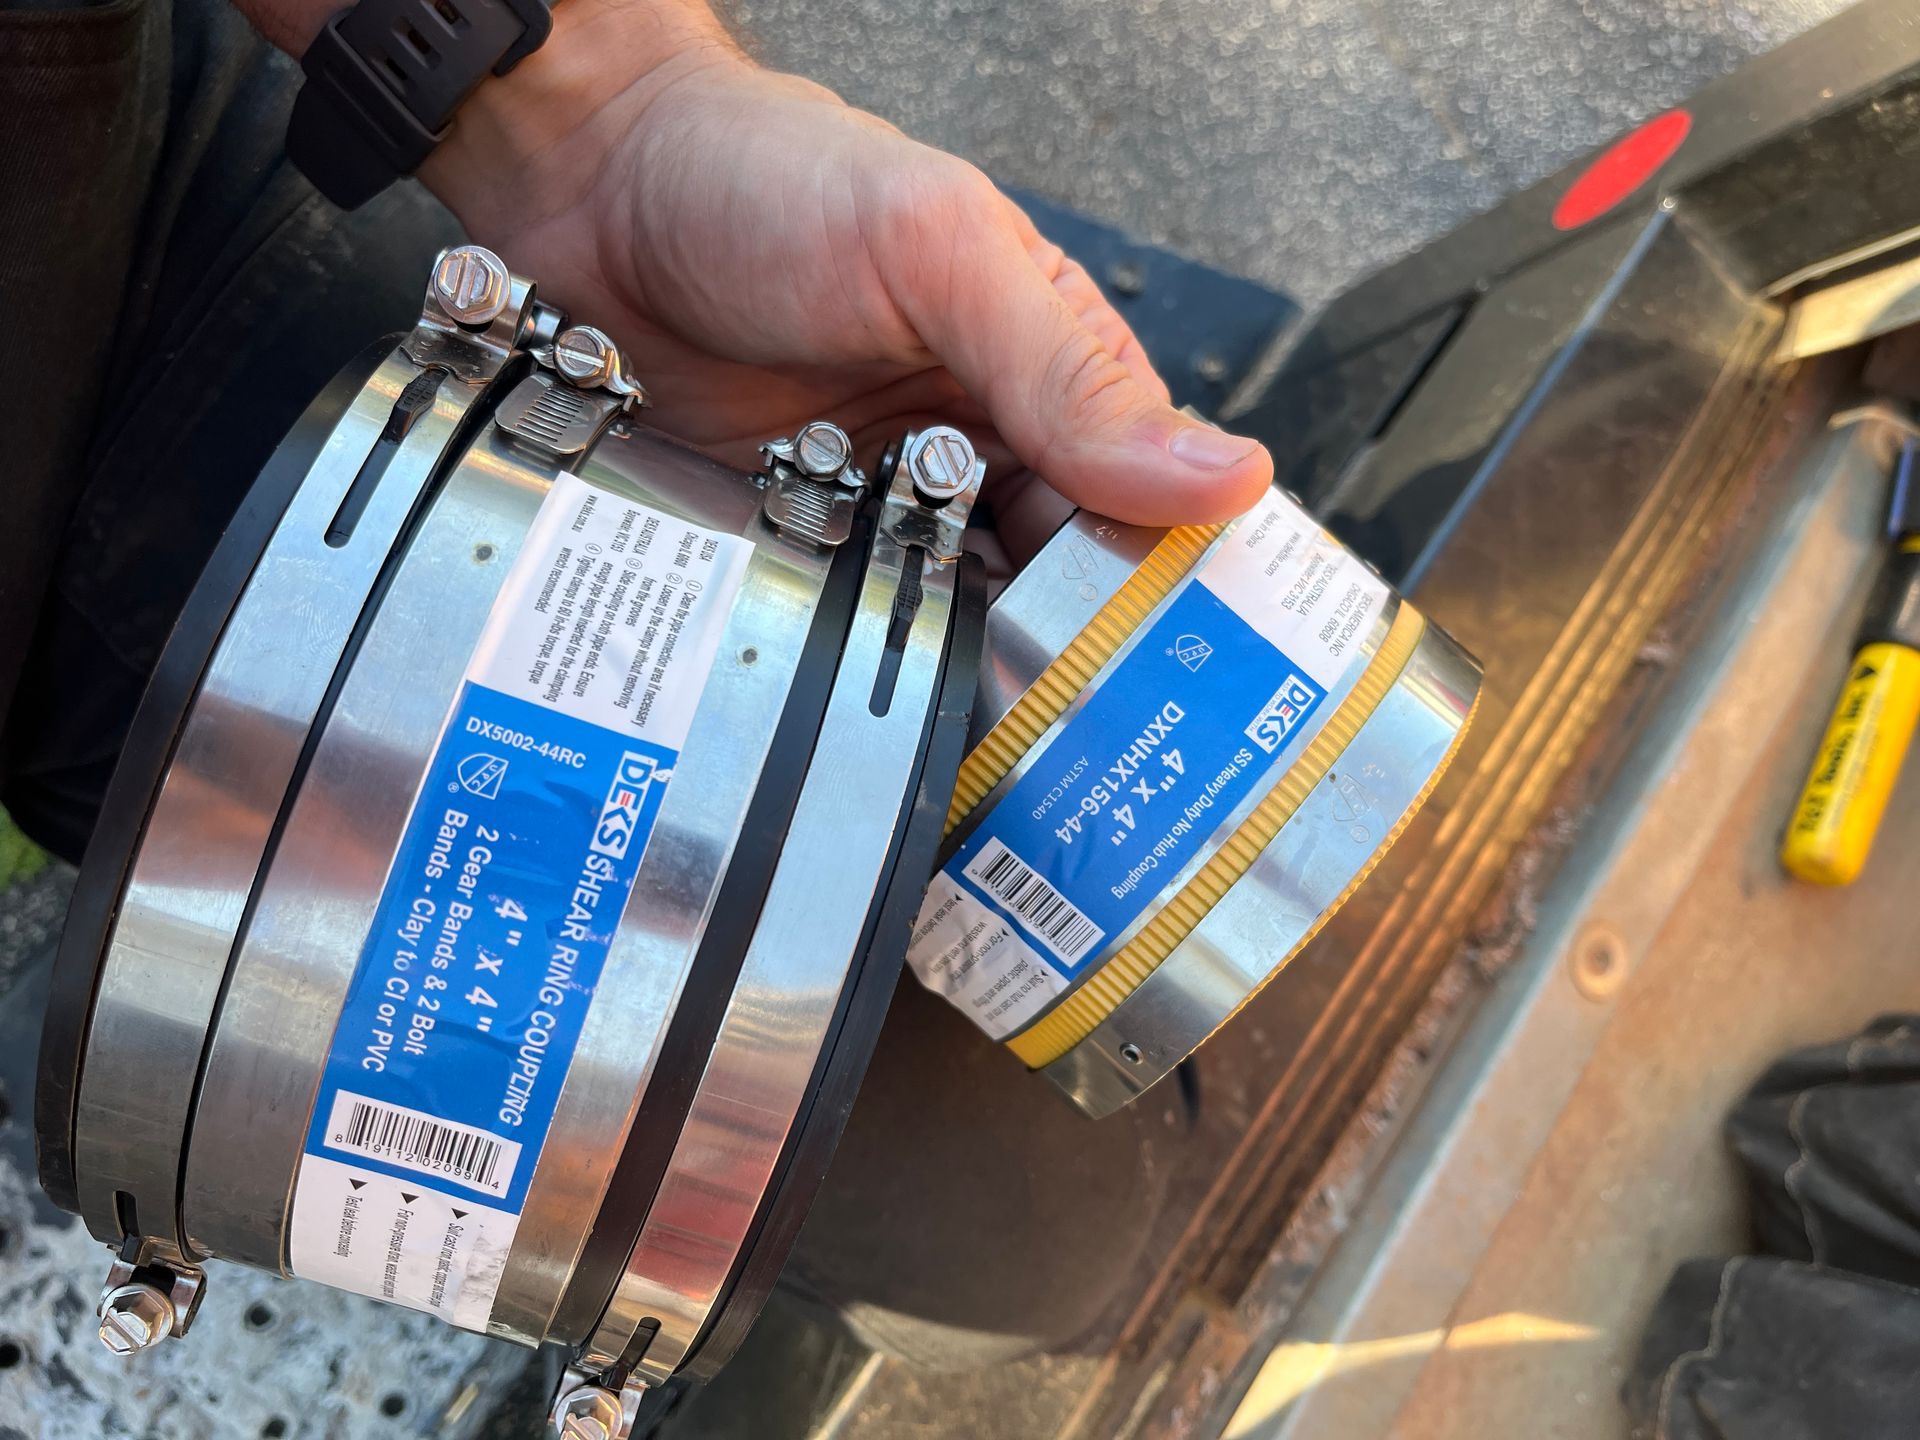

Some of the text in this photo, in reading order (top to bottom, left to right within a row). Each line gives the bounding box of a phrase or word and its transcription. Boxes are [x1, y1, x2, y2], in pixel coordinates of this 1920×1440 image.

[1244, 527, 1266, 551] China
[570, 552, 596, 579] Tighten
[618, 568, 637, 587] Slide
[533, 545, 575, 614] wrench recommended
[560, 573, 587, 601] clamps
[1292, 576, 1310, 595] VIC
[560, 597, 576, 609] to
[603, 582, 631, 613] coupling
[621, 575, 658, 628] from the grooves
[656, 583, 678, 608] Loosen
[677, 590, 697, 611] Clean
[1280, 589, 1299, 611] 3153
[1295, 575, 1329, 616] AUSTRALIA
[556, 605, 573, 618] 60
[603, 609, 617, 621] on
[647, 614, 665, 629] the
[649, 603, 666, 617] up
[674, 607, 690, 621] the
[541, 559, 617, 704] enough pipe length inserted for the clamping
[597, 619, 615, 637] both
[635, 623, 660, 651] clamps
[664, 616, 686, 636] pipe
[1317, 616, 1340, 643] 60608
[1337, 606, 1366, 642] AMERICA
[533, 632, 560, 662] torque,
[585, 632, 609, 653] pipe
[654, 631, 681, 670] connection
[1327, 638, 1345, 658] INC
[523, 657, 549, 686] torque
[582, 649, 603, 673] ends.
[628, 647, 652, 676] without
[571, 669, 595, 699] Ensure
[646, 681, 662, 691] if
[648, 666, 665, 684] area
[612, 671, 643, 711] removing
[628, 687, 658, 728] necessary
[1251, 682, 1314, 748] DEKS
[462, 715, 588, 770] DX5002-44RC
[1051, 697, 1186, 848] DXNHX156-44
[1029, 754, 1091, 821] ASTM C1540
[594, 755, 654, 852] DEKS
[1094, 799, 1144, 847] 4"
[1108, 746, 1254, 903] SS Heavy Duty No Hub Coupling
[423, 807, 469, 882] Bands
[394, 893, 438, 948] Clay
[964, 919, 987, 942] waste
[400, 823, 501, 1057] 2 Gear Bands & 2 Bolt
[986, 930, 1004, 947] For
[391, 947, 419, 974] to
[472, 950, 504, 977] x
[1005, 958, 1030, 980] plastic
[494, 851, 613, 1128] SHEAR RING COUPLING
[1018, 981, 1033, 994] no
[374, 1001, 397, 1026] or
[359, 1028, 395, 1074] PVC
[342, 1205, 359, 1221] leak
[344, 1193, 362, 1209] Test
[442, 1233, 459, 1250] cast
